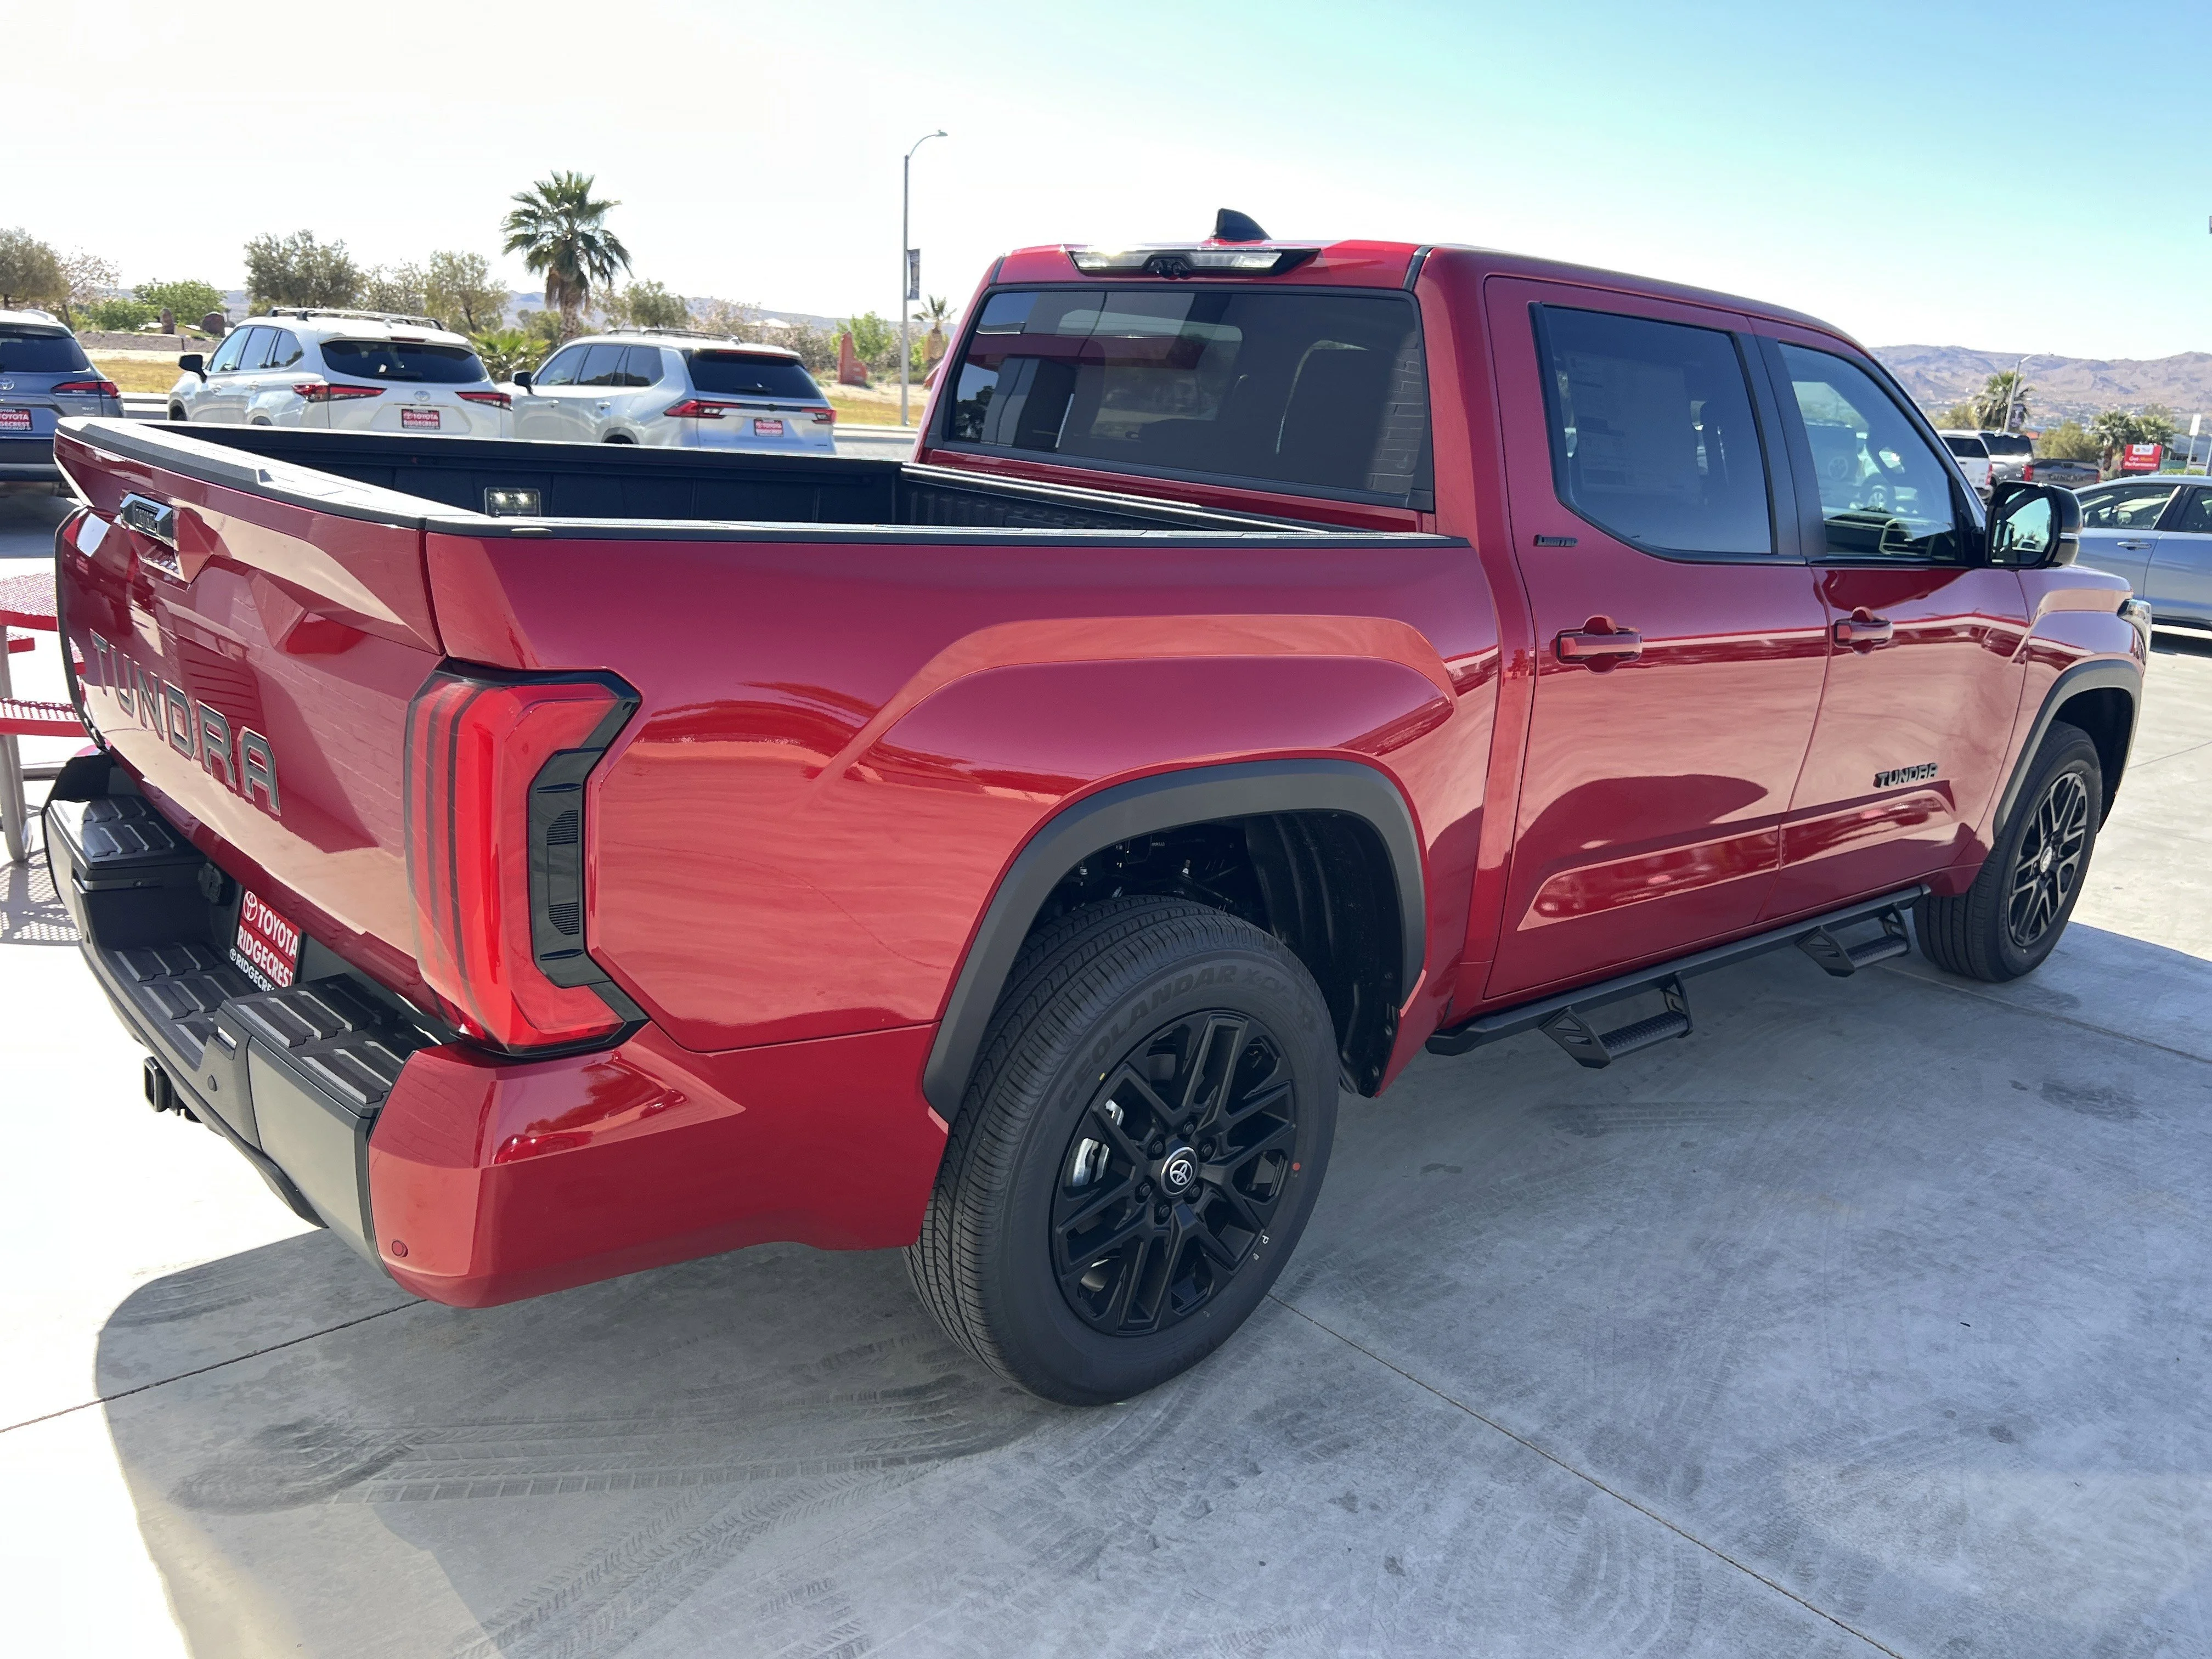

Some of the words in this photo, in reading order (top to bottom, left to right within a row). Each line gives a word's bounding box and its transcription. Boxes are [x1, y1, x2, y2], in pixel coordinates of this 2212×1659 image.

[89, 628, 281, 817] TUNDRA
[1873, 762, 1938, 788] TUNDRA
[236, 924, 294, 988] RIDGECREST
[258, 903, 298, 958] TOYOTA
[235, 953, 275, 992] RIDGECRE
[1058, 964, 1237, 1113] GEOLANDAR
